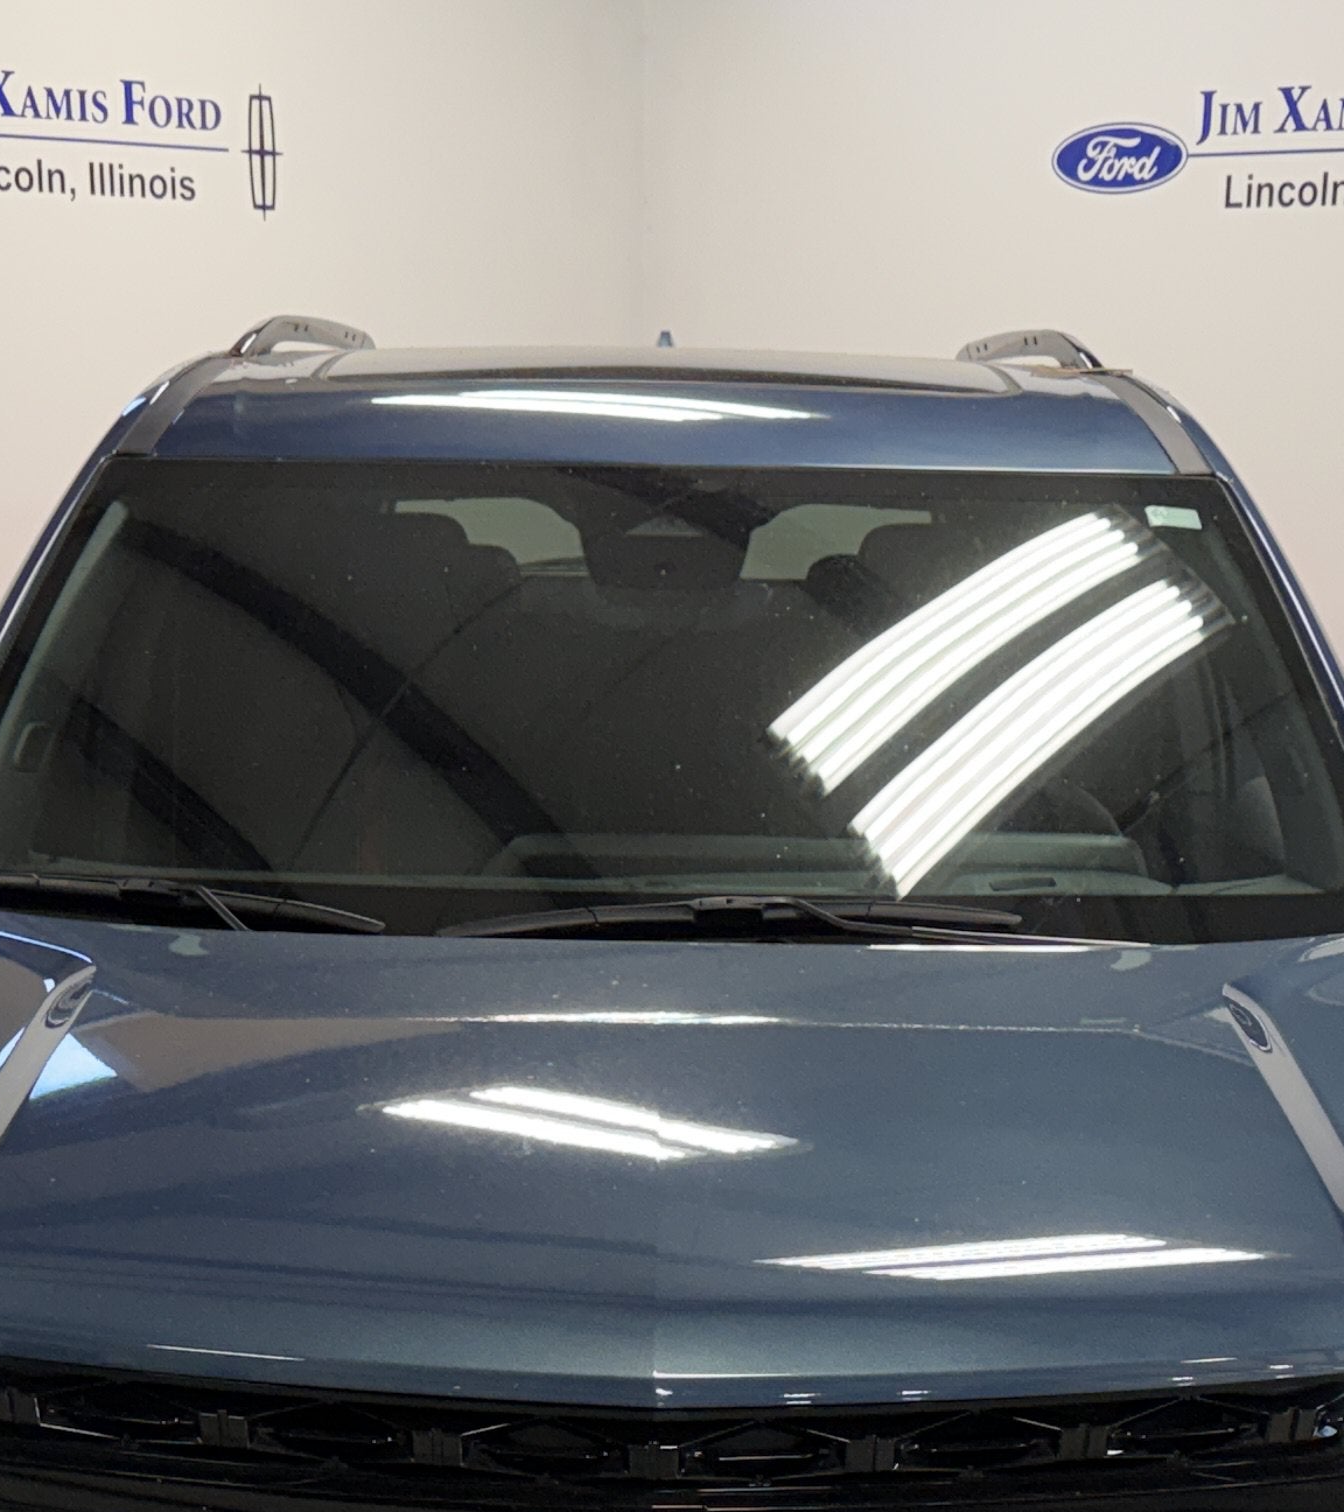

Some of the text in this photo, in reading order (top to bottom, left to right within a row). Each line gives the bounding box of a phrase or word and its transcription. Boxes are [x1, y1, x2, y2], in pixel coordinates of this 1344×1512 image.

[120, 79, 223, 131] FORD
[1196, 89, 1263, 146] JIM
[89, 161, 197, 202] Illinois
[1077, 135, 1160, 182] Ford
